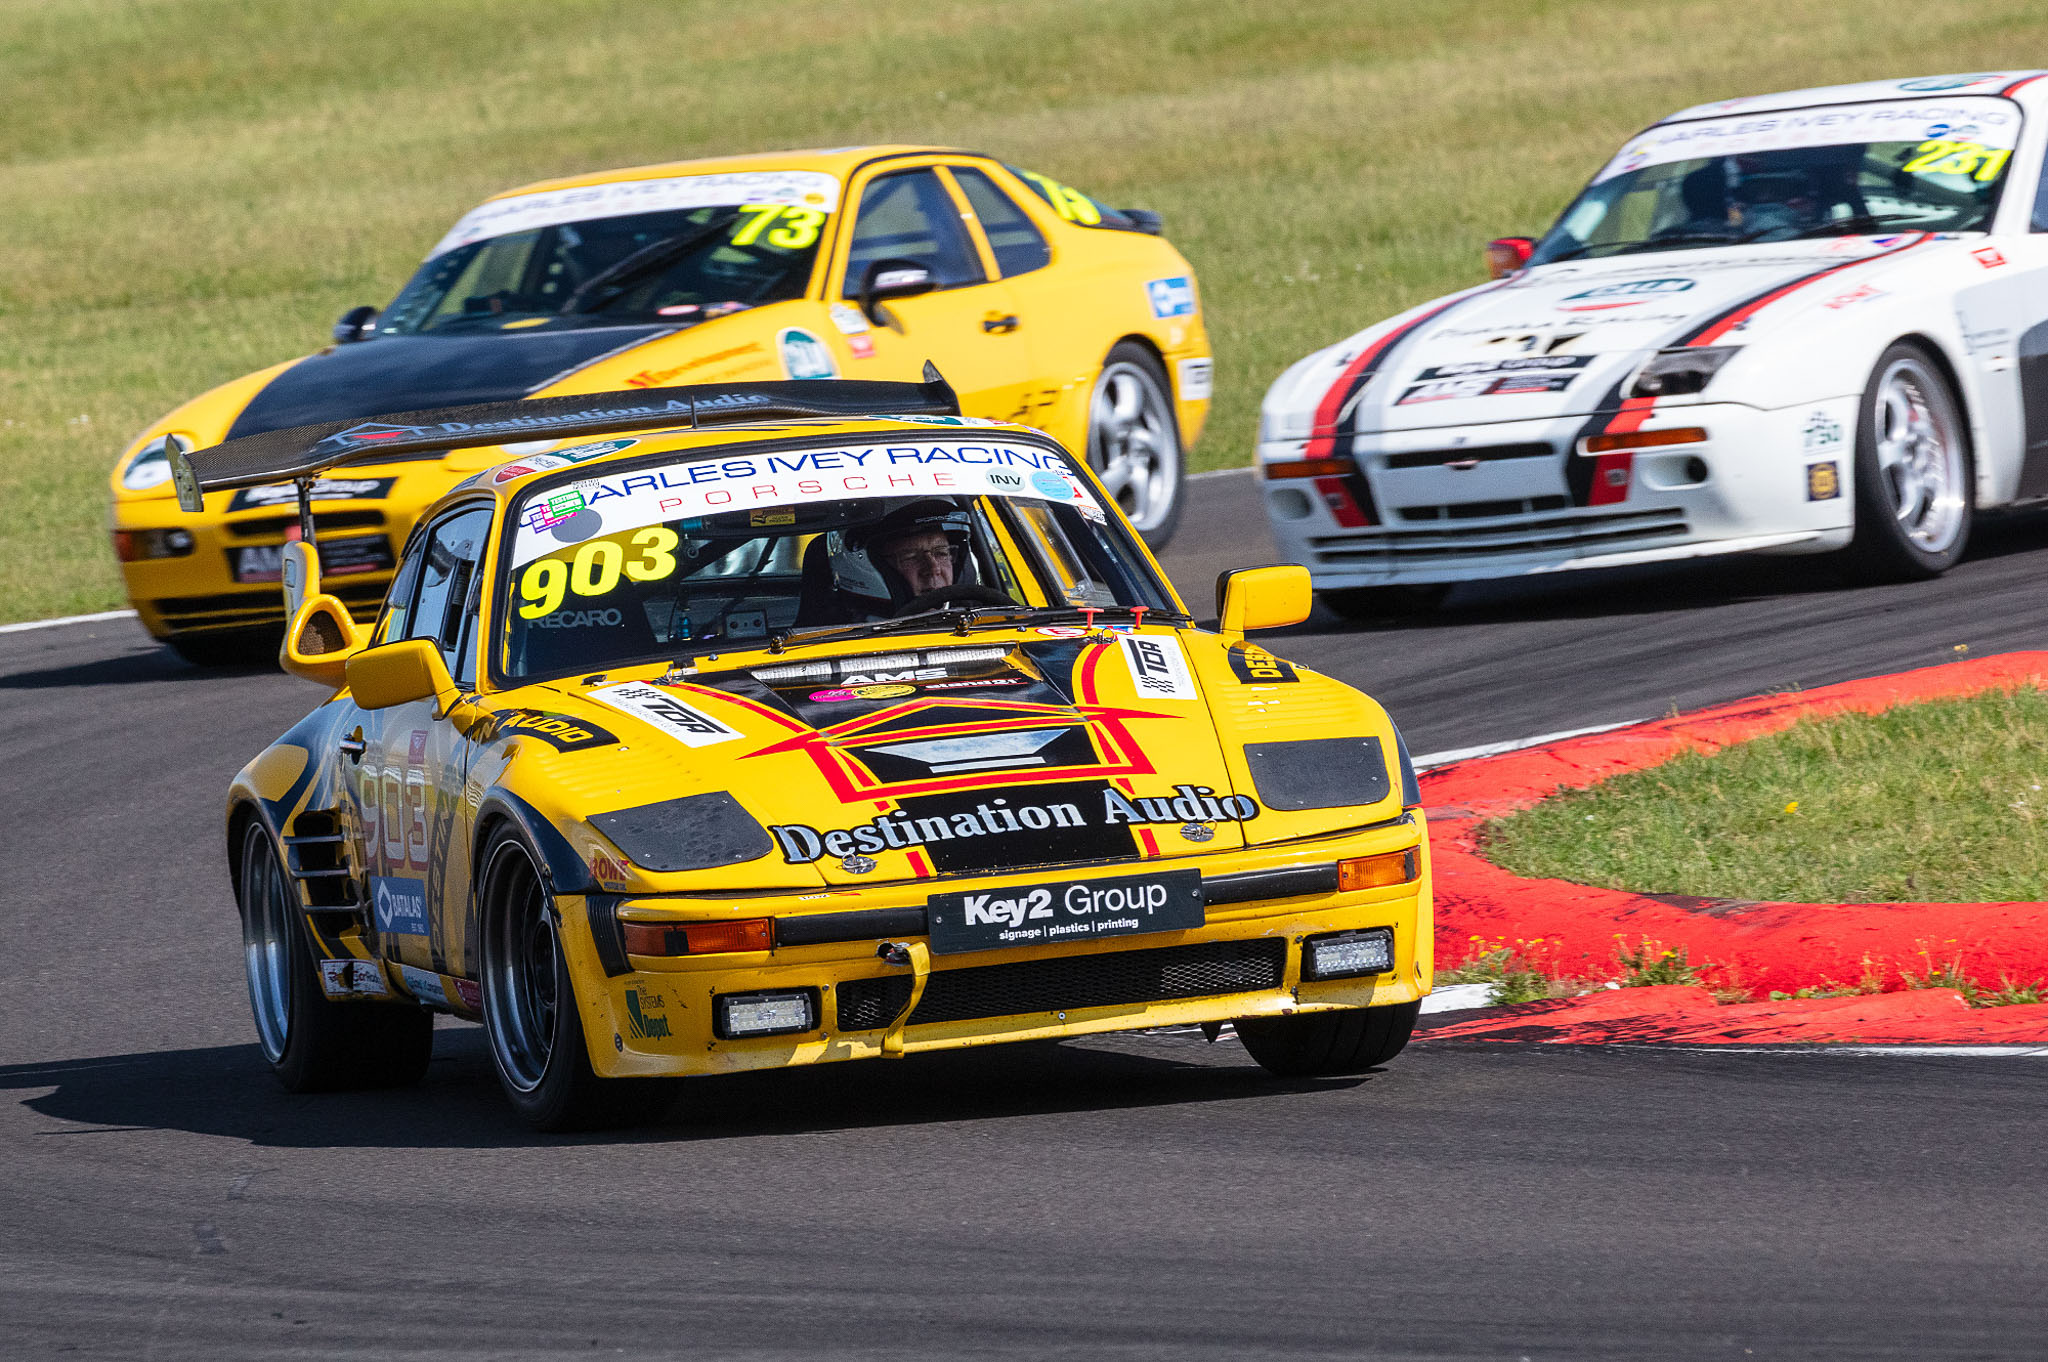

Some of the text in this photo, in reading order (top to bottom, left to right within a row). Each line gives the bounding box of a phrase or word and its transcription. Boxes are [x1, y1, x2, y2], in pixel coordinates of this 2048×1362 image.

[731, 204, 826, 249] 73
[438, 393, 770, 433] Destination Audio
[767, 449, 874, 473] IVEY
[990, 474, 1021, 486] INV
[659, 473, 957, 513] PORSCHE
[519, 527, 679, 620] 903
[841, 667, 948, 686] AMS
[497, 714, 594, 744] AUDIO
[360, 763, 429, 870] 903
[771, 784, 1259, 864] Destination Audio
[963, 884, 1167, 928] Key2 Group
[999, 917, 1139, 941] signage plastics printing
[643, 1014, 673, 1041] Depot
